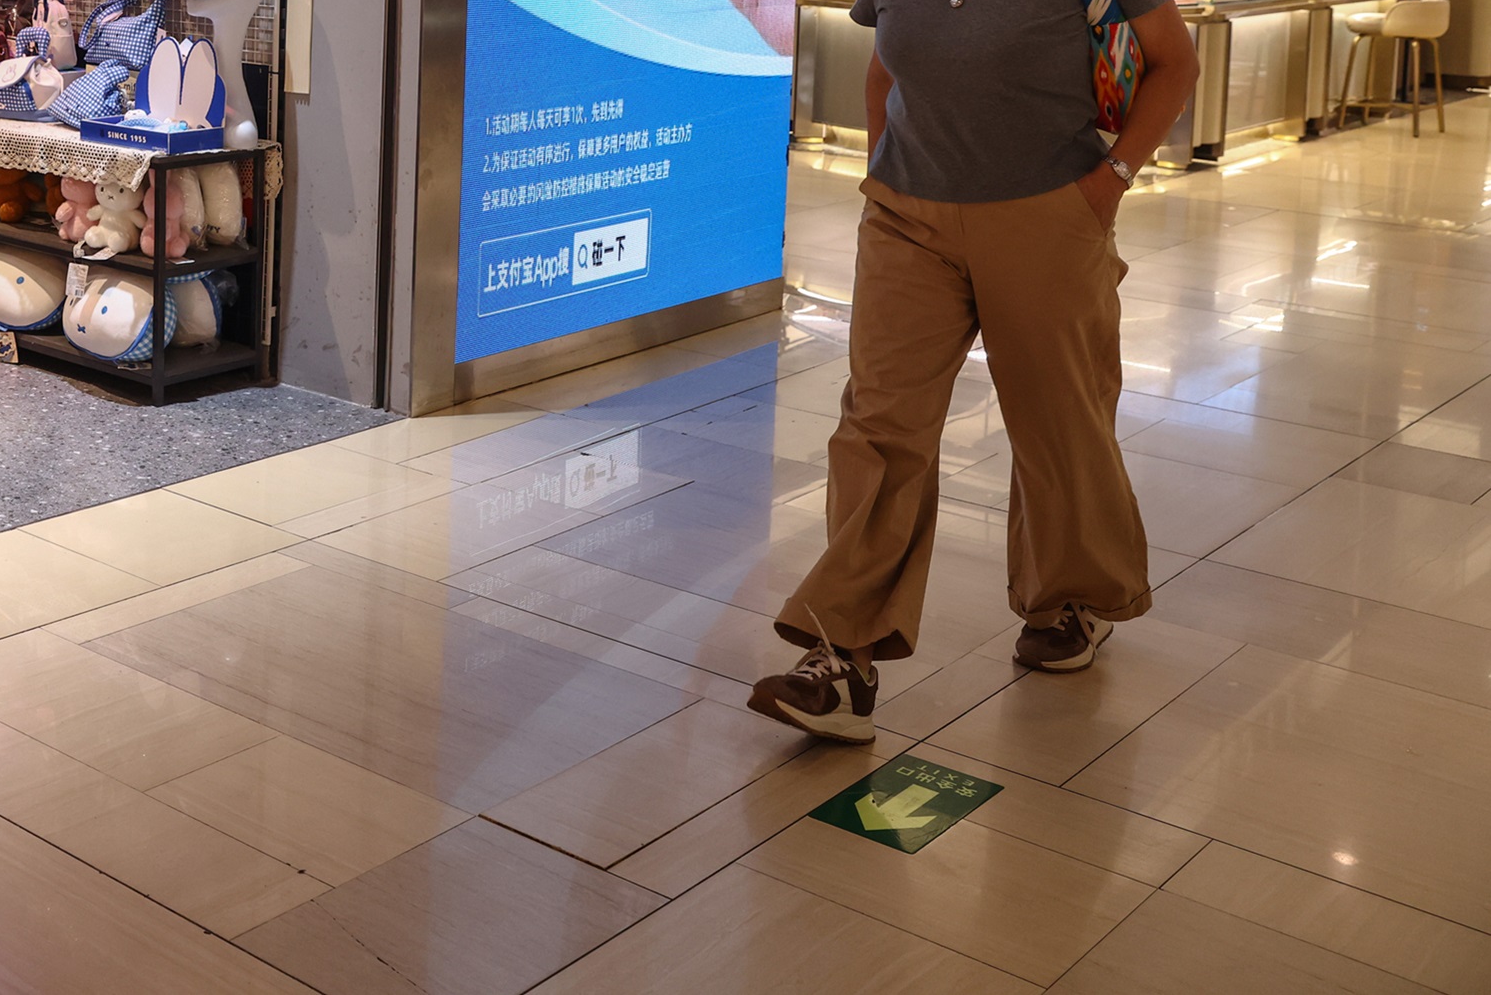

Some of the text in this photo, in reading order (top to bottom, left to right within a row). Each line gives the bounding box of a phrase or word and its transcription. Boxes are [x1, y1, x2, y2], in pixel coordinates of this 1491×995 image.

[108, 130, 147, 144] SINCE 1955
[591, 235, 626, 267] 碰一下
[483, 246, 570, 294] 上支付宝App搜
[895, 766, 978, 799] 安全出口
[916, 764, 975, 787] EXIT
